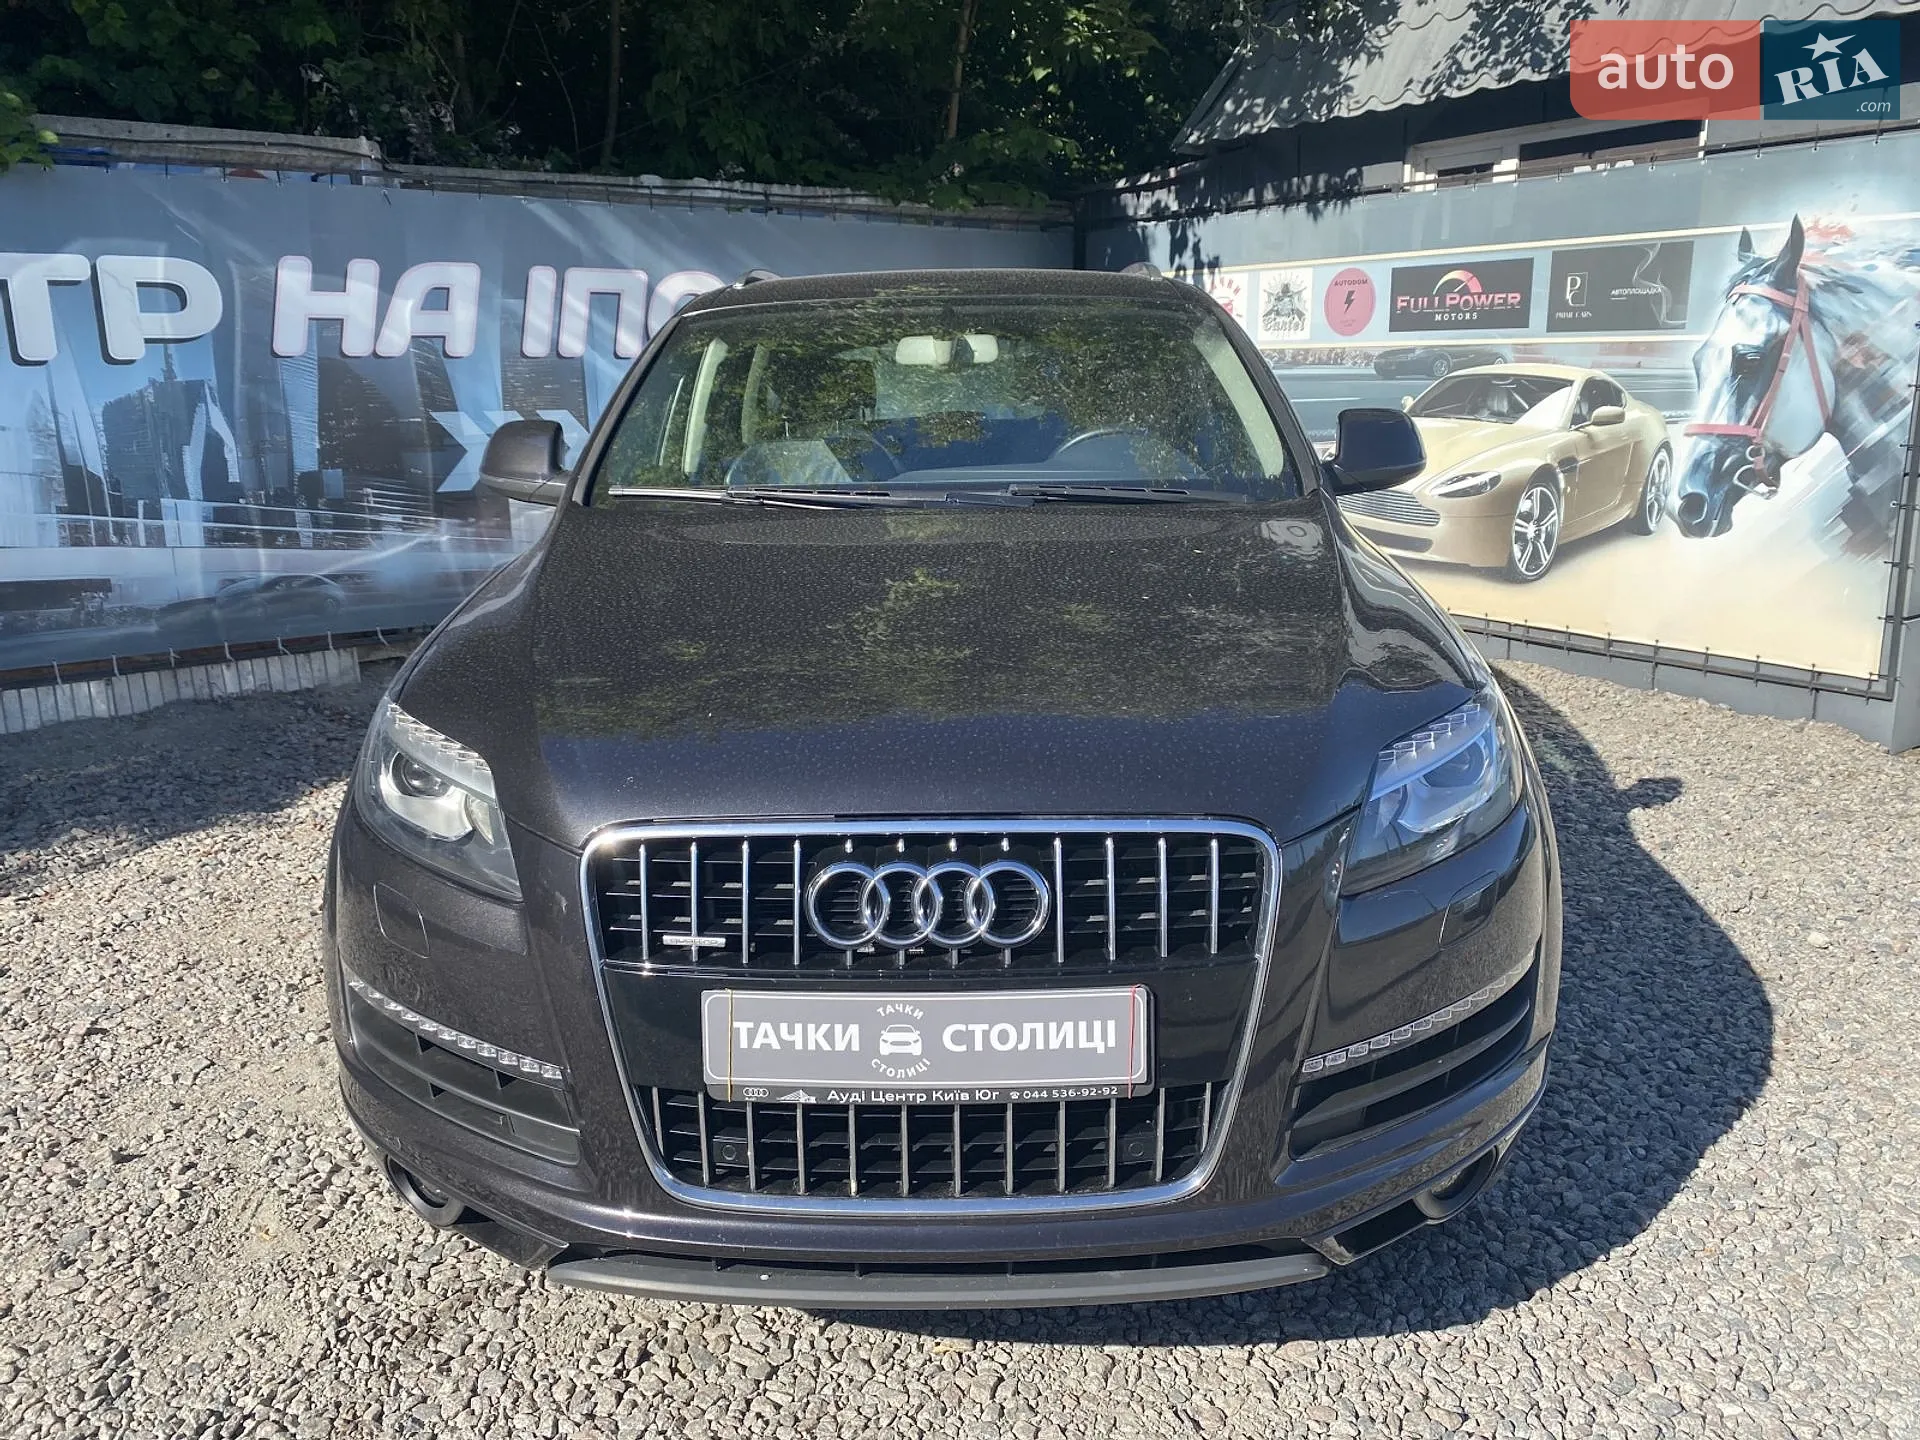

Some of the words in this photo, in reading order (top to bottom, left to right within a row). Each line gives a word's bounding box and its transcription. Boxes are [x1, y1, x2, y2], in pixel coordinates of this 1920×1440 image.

[1334, 278, 1369, 287] AUTODOM
[273, 255, 482, 359] НА
[1434, 312, 1478, 321] MOTORS
[877, 1003, 924, 1020] ТАЧКИ
[734, 1021, 860, 1052] ТАЧКИ
[942, 1019, 1116, 1055] СТОЛИЦІ
[871, 1058, 930, 1079] СТОЛИЦІ
[827, 1090, 865, 1103] Ауді
[871, 1090, 927, 1104] Центр
[933, 1089, 970, 1101] Київ
[976, 1089, 1000, 1101] Юг
[1023, 1089, 1048, 1099] 044
[1052, 1086, 1118, 1098] 536-92-92
